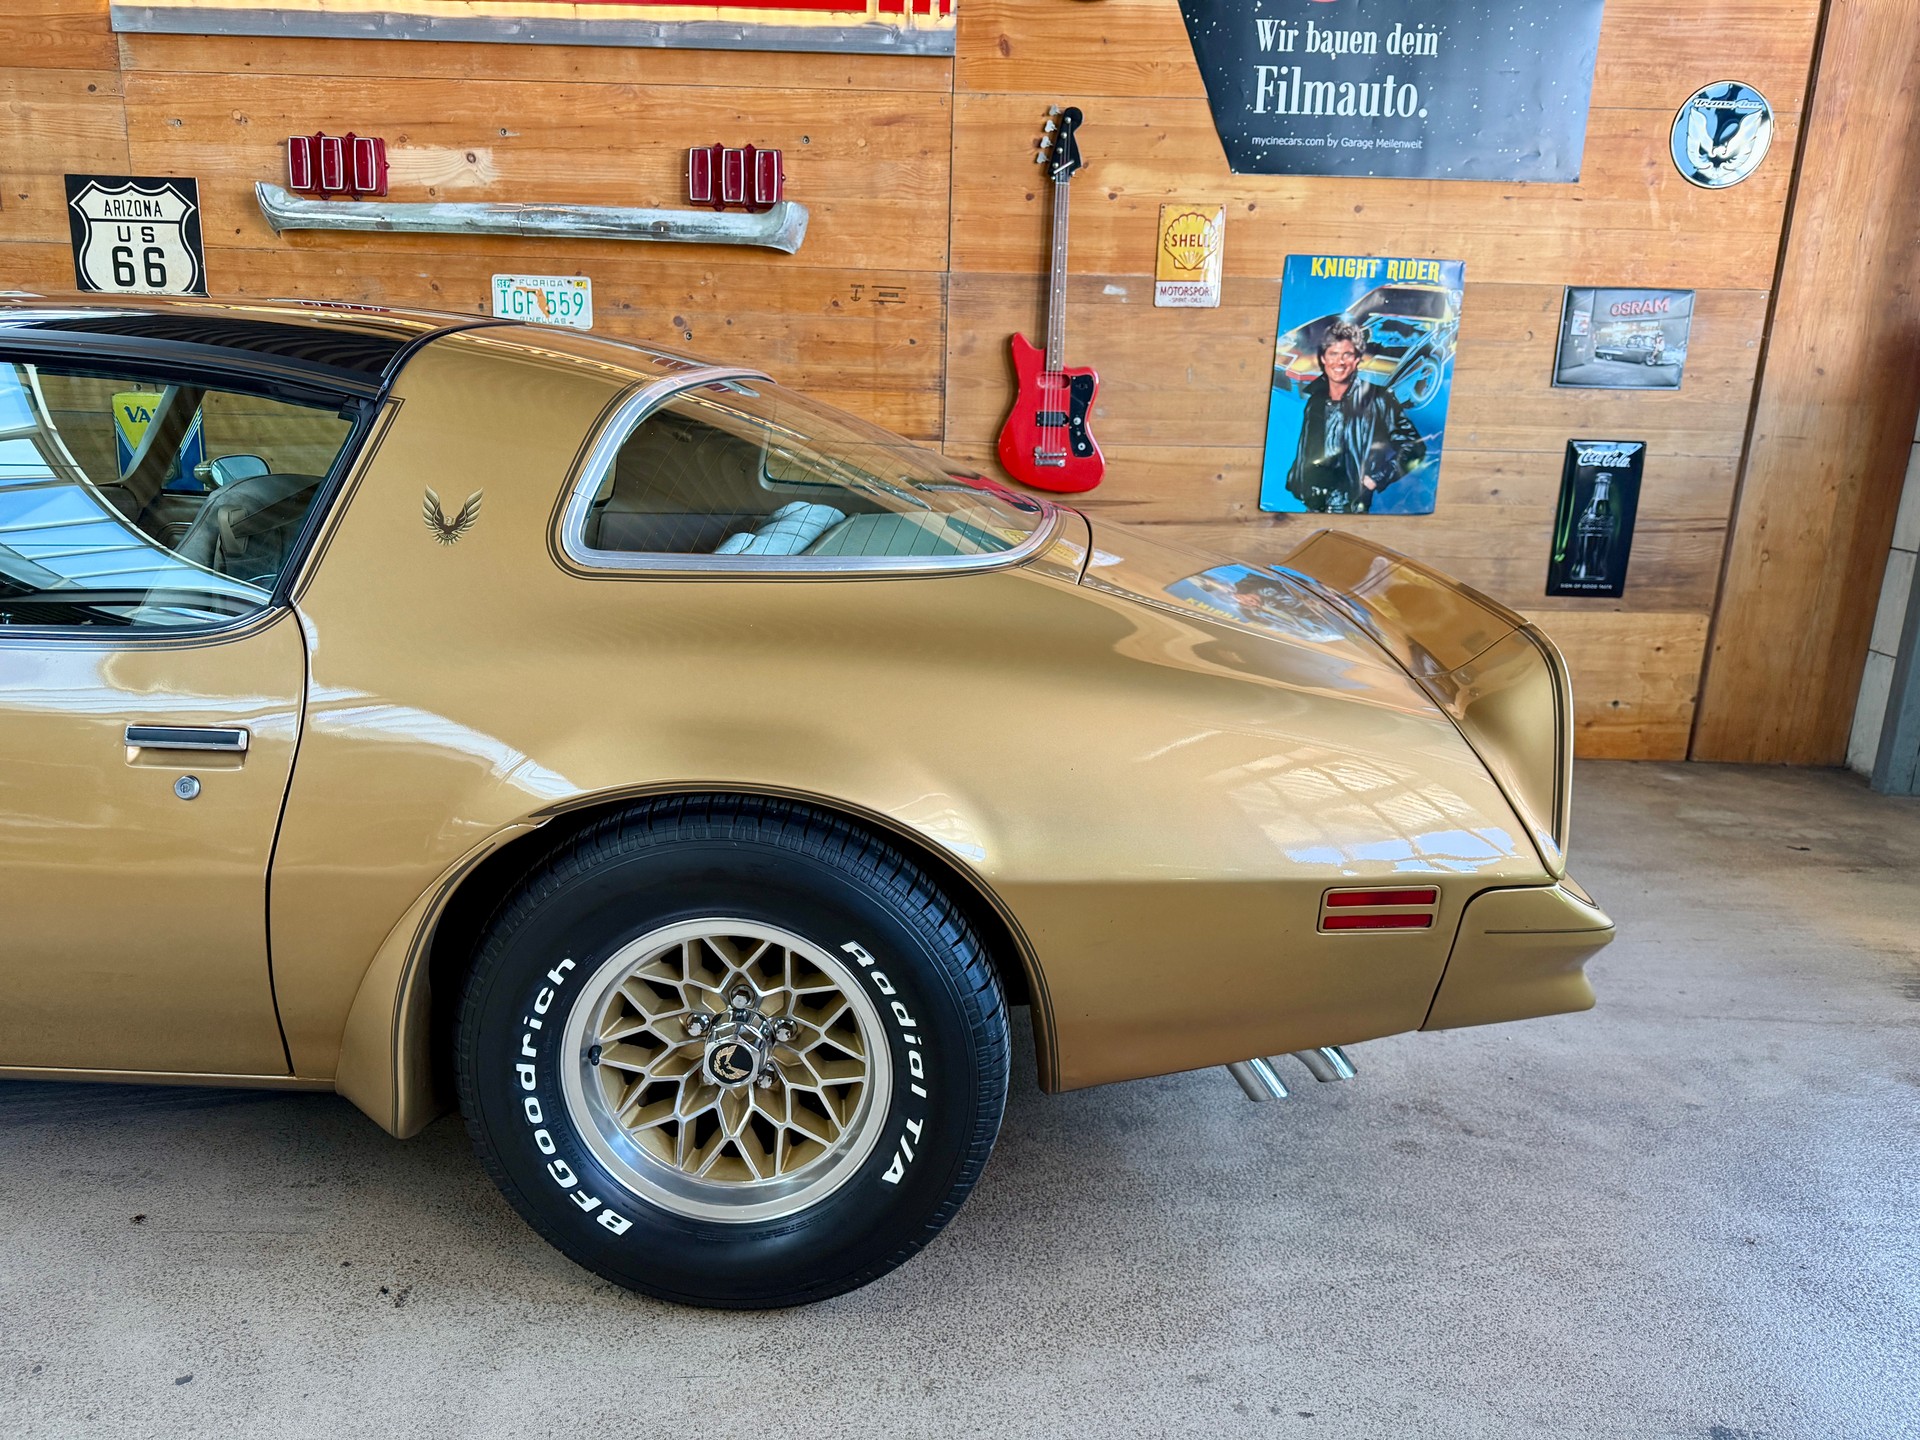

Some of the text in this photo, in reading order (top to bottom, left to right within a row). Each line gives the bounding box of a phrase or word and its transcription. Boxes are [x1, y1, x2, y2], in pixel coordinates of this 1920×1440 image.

[1255, 19, 1438, 56] Wir bauen dein
[1253, 65, 1428, 119] Filmauto.
[1252, 136, 1423, 149] mycinecars.com by Garage Meilenweit
[104, 199, 163, 218] ARIZONA
[1171, 234, 1210, 248] SHELL
[111, 245, 168, 288] 66
[1311, 257, 1441, 283] KNIGHT RIDER
[519, 279, 564, 288] FLORIDA
[500, 289, 584, 316] IGF 559
[1611, 297, 1671, 317] OSRAM
[840, 940, 927, 1185] Radial T/A
[515, 958, 634, 1236] BFGoodrich
